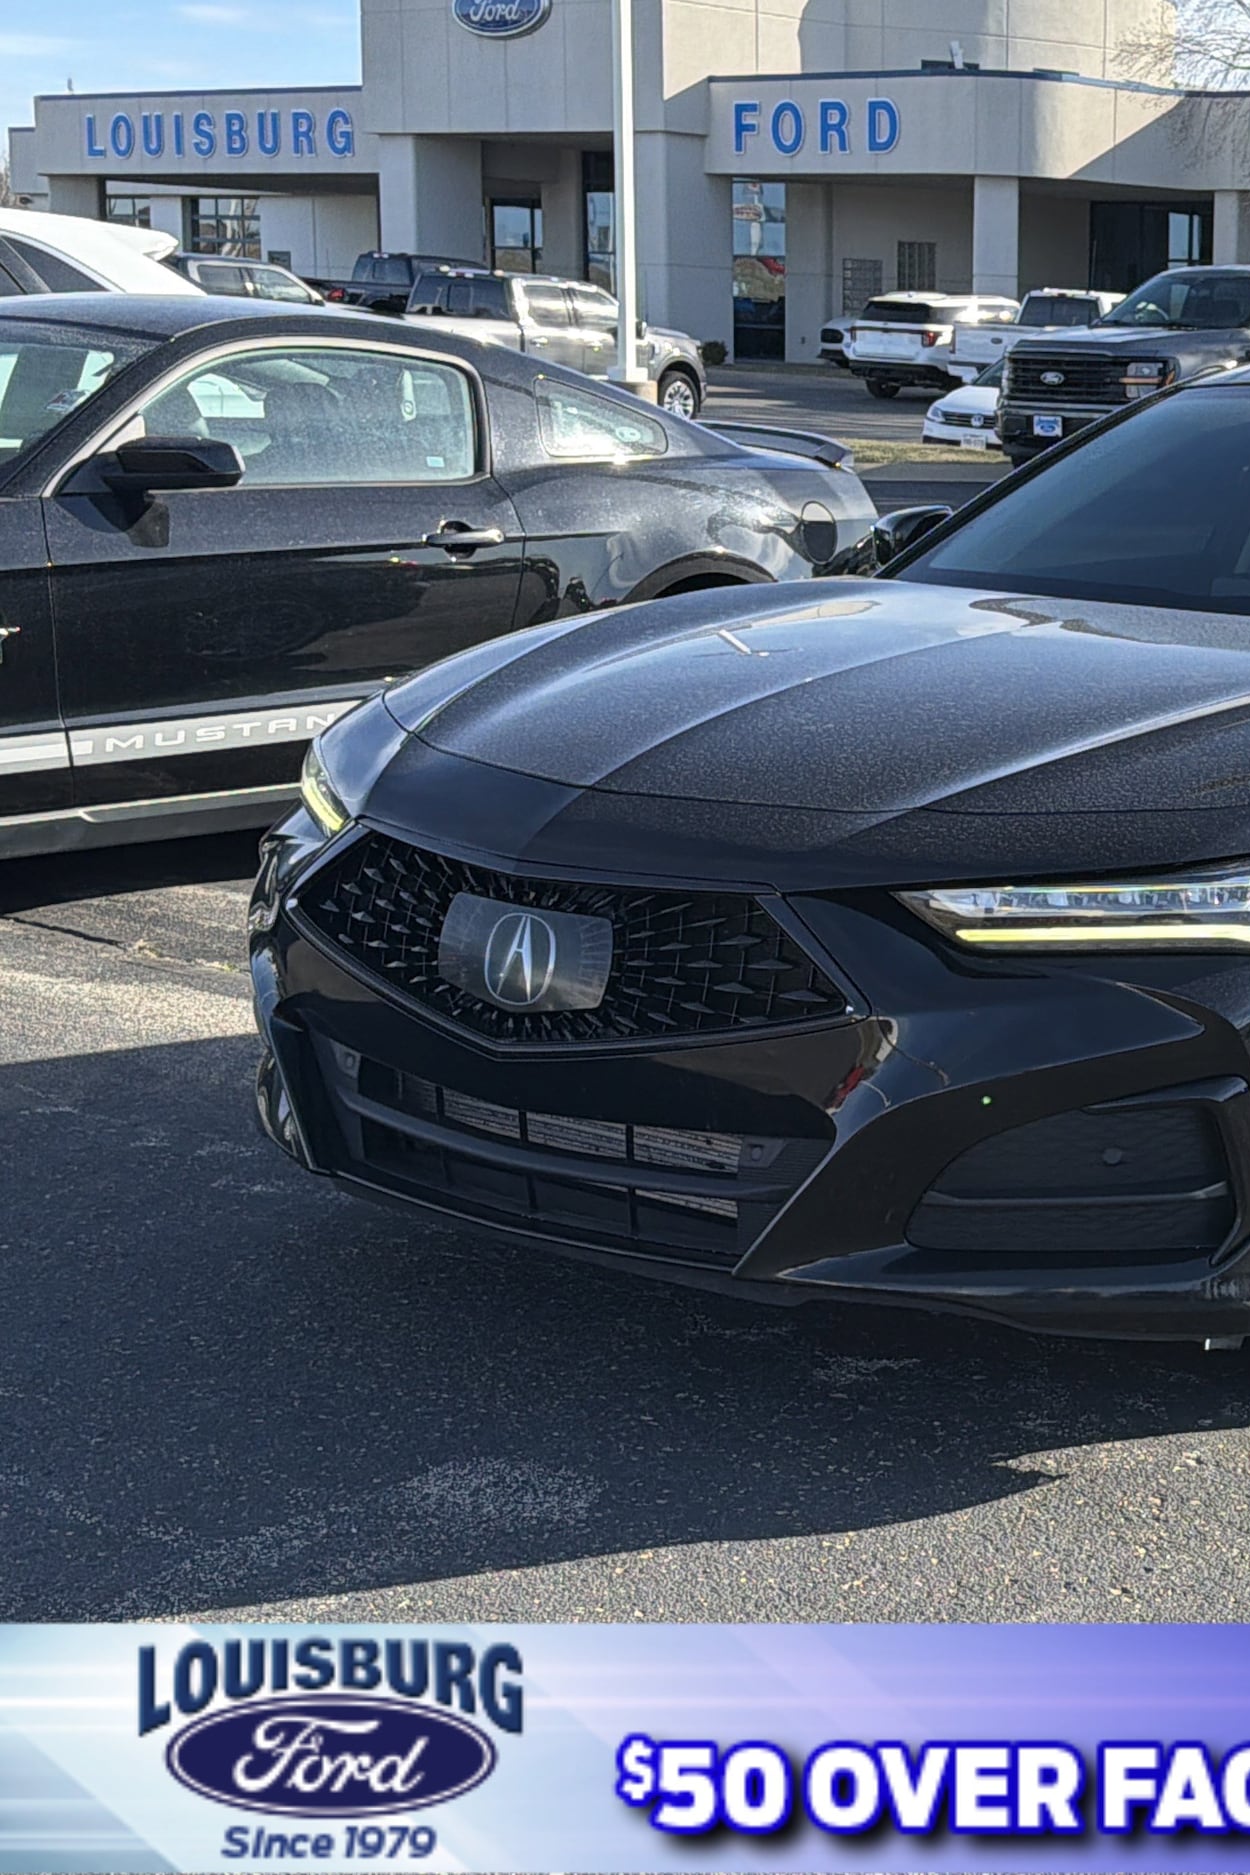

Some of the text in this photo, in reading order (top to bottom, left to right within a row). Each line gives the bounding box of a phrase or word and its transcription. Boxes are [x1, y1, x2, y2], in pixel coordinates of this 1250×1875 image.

[84, 107, 354, 159] LOUISBURG
[733, 97, 900, 156] FORD
[105, 711, 337, 753] MUSTAN
